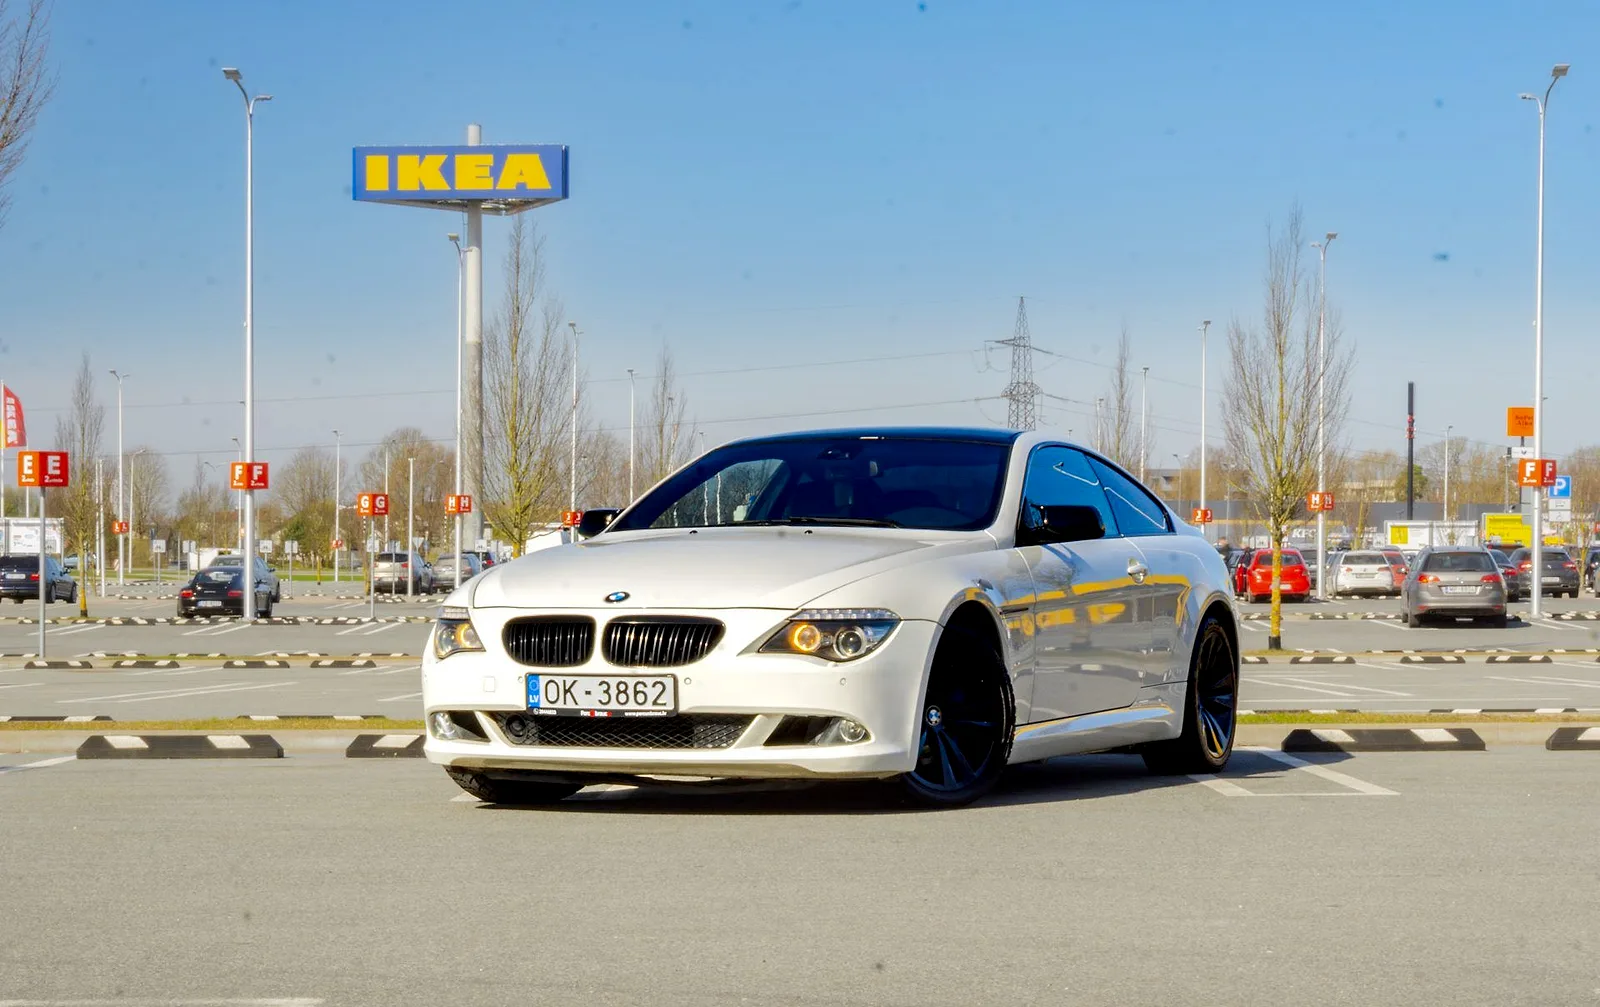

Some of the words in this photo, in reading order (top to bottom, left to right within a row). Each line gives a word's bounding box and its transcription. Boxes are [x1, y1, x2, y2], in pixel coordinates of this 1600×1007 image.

[365, 153, 552, 191] IKEA
[23, 455, 33, 475] E
[47, 455, 61, 475] E
[235, 465, 243, 480] F
[253, 465, 263, 480] F
[1526, 462, 1536, 477] F
[1545, 462, 1553, 477] F
[1553, 478, 1566, 496] P
[361, 496, 369, 509] G
[375, 496, 385, 509] G
[448, 496, 455, 507] H
[460, 496, 469, 508] H
[1311, 493, 1320, 504] H
[528, 694, 540, 703] LV
[544, 679, 667, 706] OK-3862
